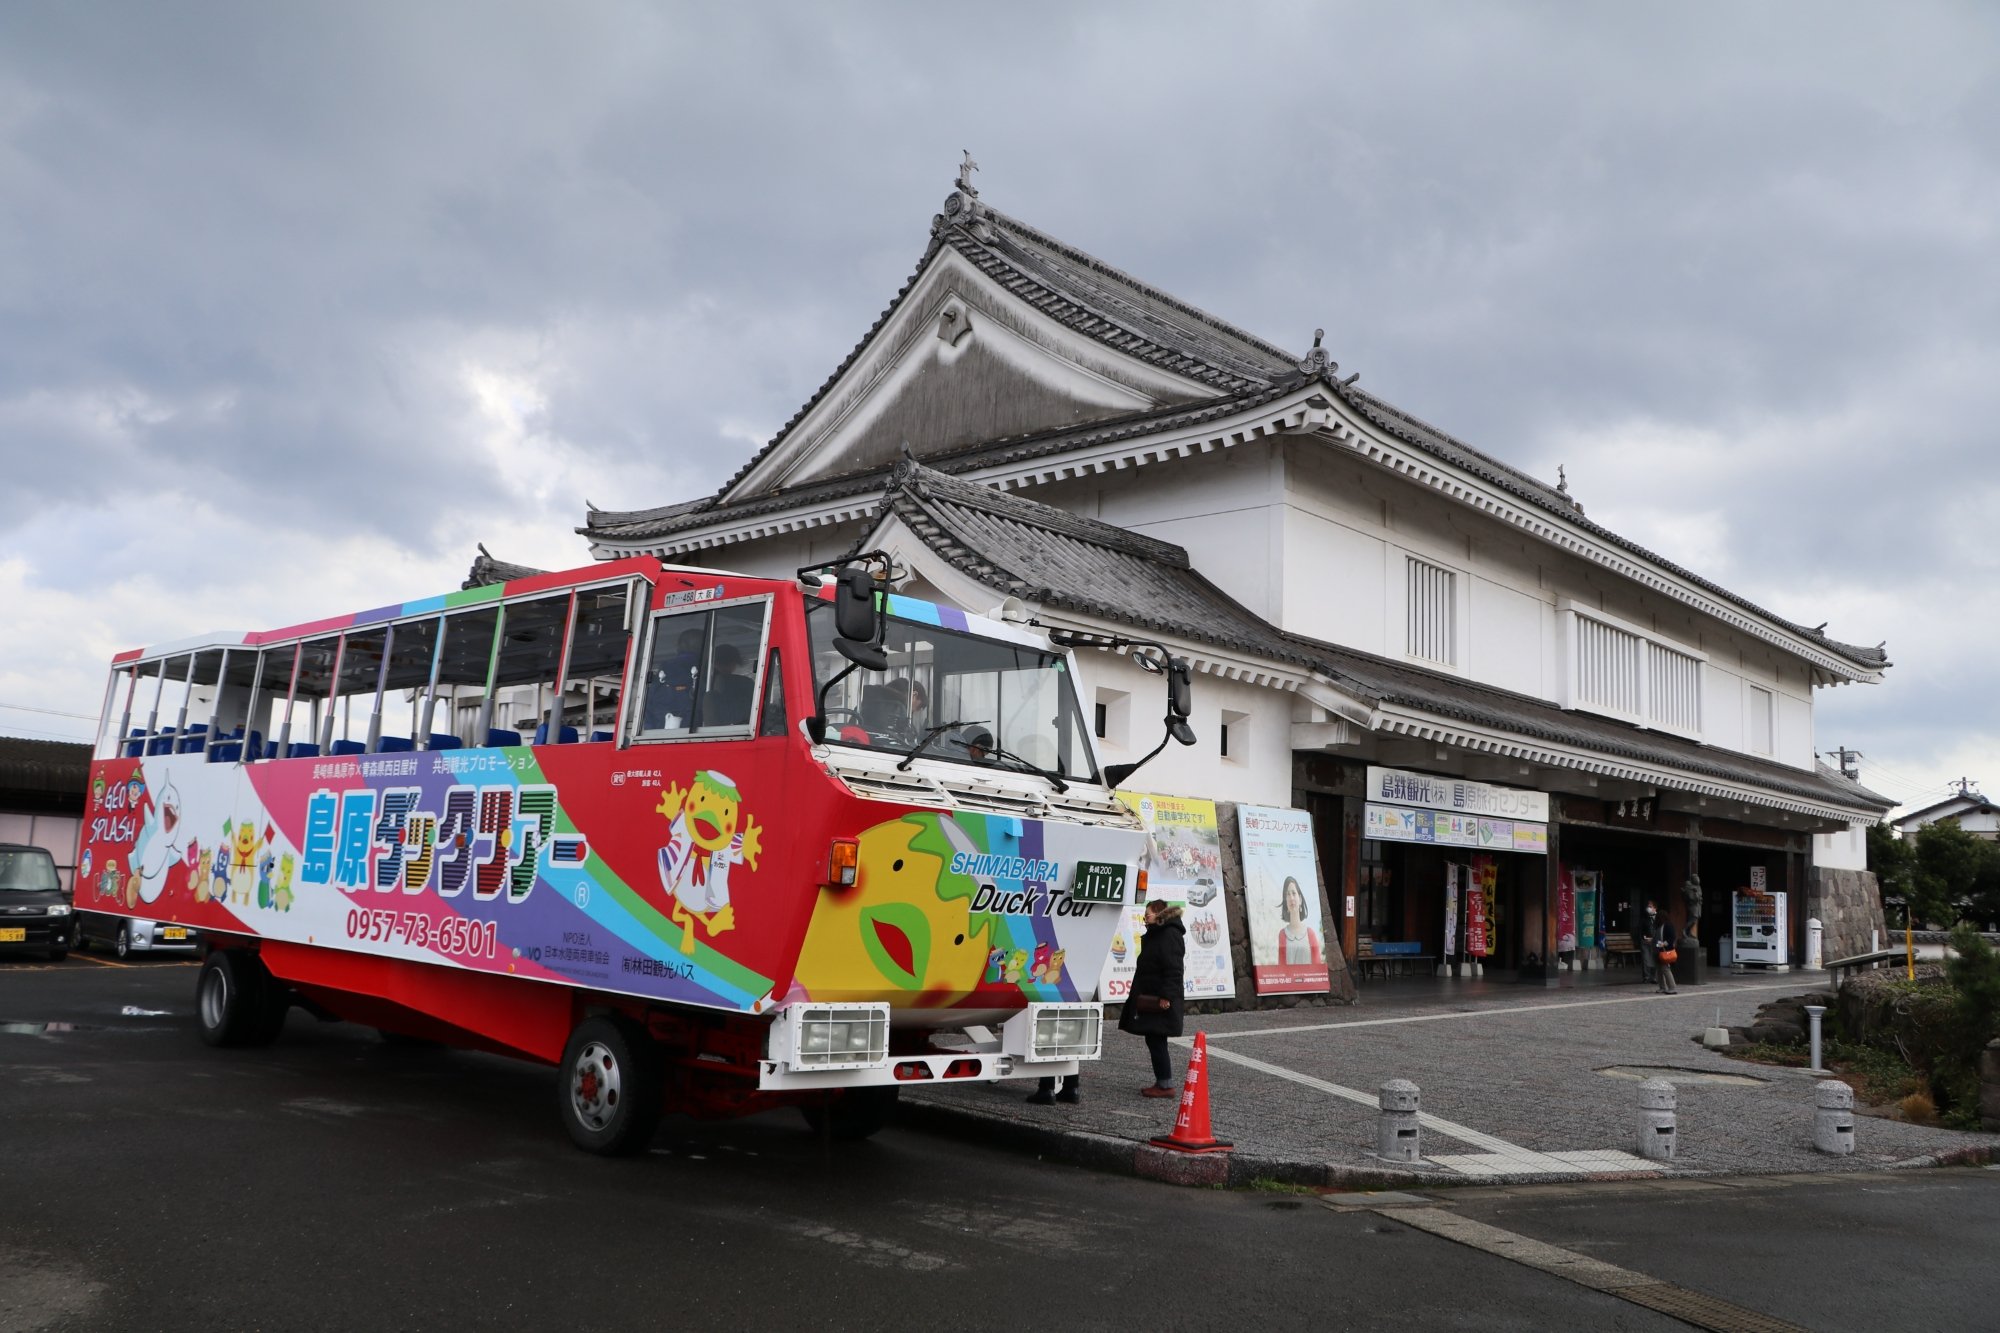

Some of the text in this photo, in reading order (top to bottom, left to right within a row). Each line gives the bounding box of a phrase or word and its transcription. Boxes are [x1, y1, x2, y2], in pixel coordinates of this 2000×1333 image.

[432, 754, 537, 775] 共同観光プロモーション
[104, 780, 126, 812] GEO
[1140, 800, 1153, 810] SDS
[1381, 773, 1540, 816] 島鉄観光(株) 島原旅行センター
[89, 815, 137, 844] SPLASH
[301, 785, 590, 903] 島原ダックツアー
[950, 852, 1060, 882] SHIMABARA
[970, 884, 1097, 918] Duck Tour
[346, 908, 497, 959] 0957-73-6501
[563, 932, 592, 946] NPO法人
[543, 945, 610, 966] 日本水陸両用車協会
